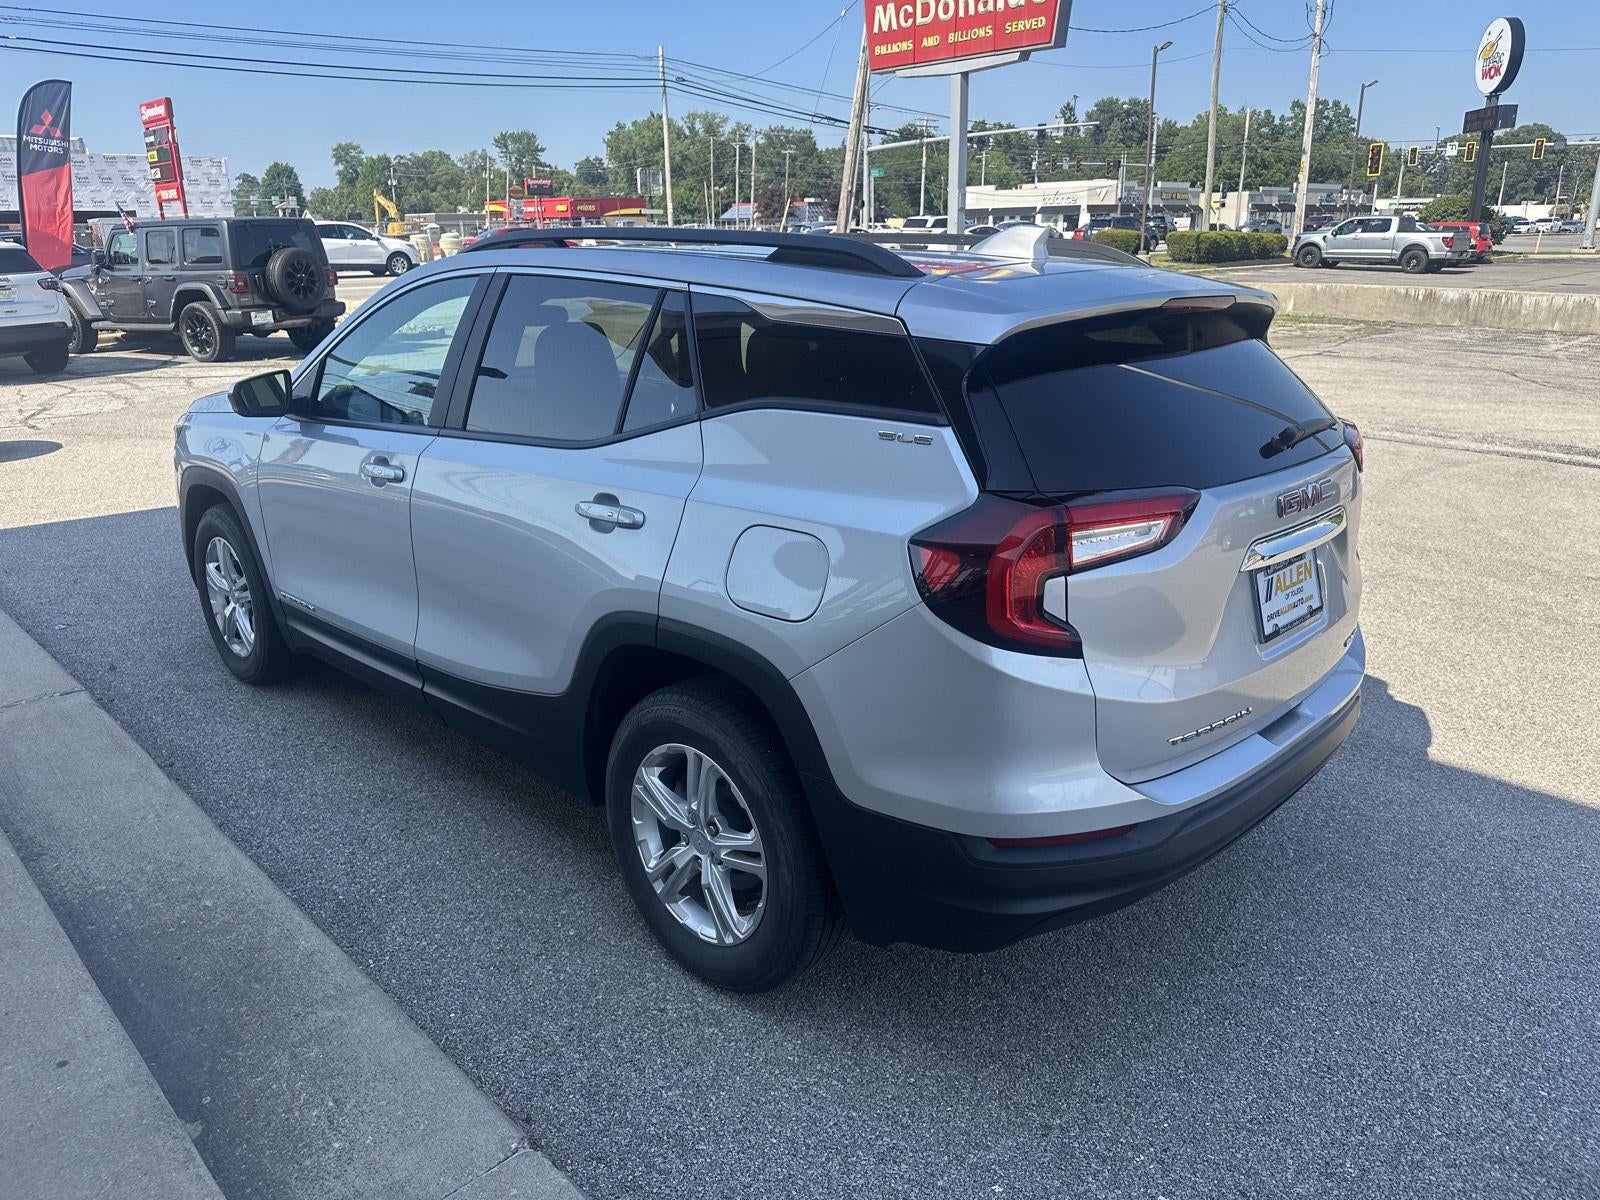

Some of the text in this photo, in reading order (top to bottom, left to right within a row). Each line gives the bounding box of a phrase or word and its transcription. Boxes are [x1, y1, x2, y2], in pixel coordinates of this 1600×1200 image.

[873, 0, 1047, 34] McDona
[875, 16, 1046, 56] BILLIONS AND BILLIONS SERVED
[1482, 64, 1502, 80] WOK
[23, 135, 69, 148] MITSUBISHI
[29, 143, 64, 154] MOTORS
[878, 430, 933, 445] SLE
[1278, 478, 1336, 517] GMC
[1275, 560, 1313, 596] ALLEN
[1291, 586, 1304, 597] TOLEDO
[1167, 706, 1253, 745] TERRAIN
